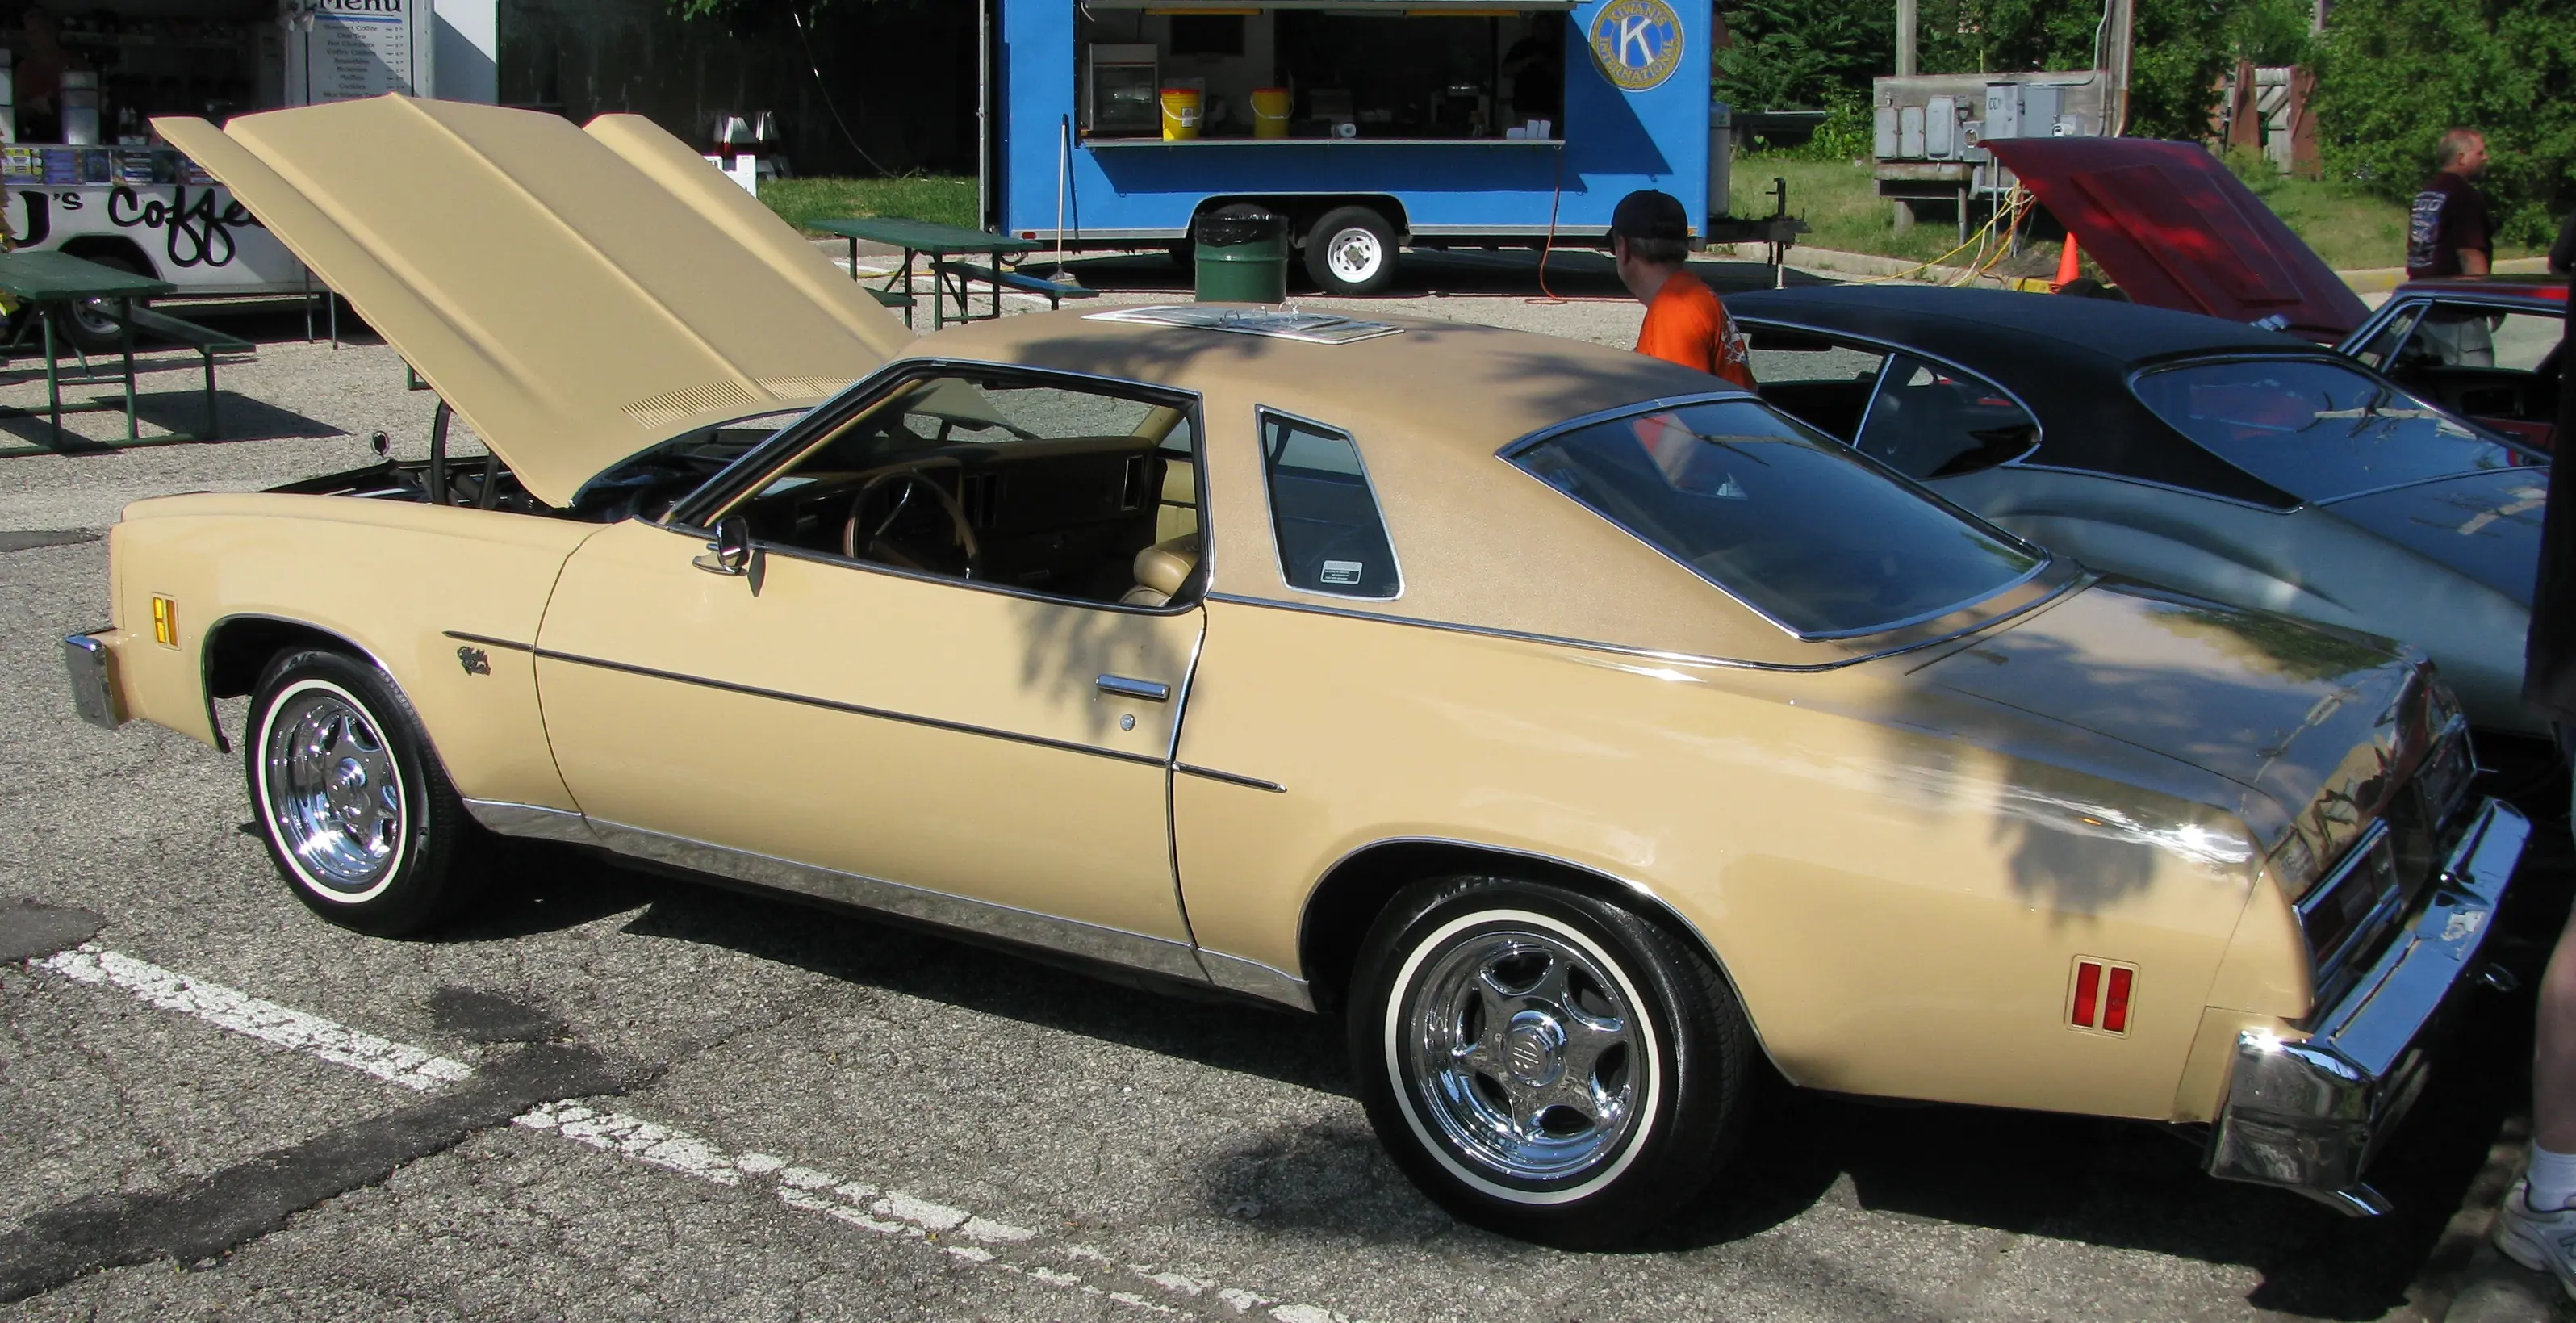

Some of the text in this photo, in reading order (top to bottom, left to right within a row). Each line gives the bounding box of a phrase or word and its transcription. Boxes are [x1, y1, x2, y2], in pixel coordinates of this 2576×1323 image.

[1607, 3, 1667, 26] KIWANIS
[1599, 36, 1675, 82] INTERNATIONAL
[1619, 16, 1656, 67] K
[108, 185, 267, 268] Coffe
